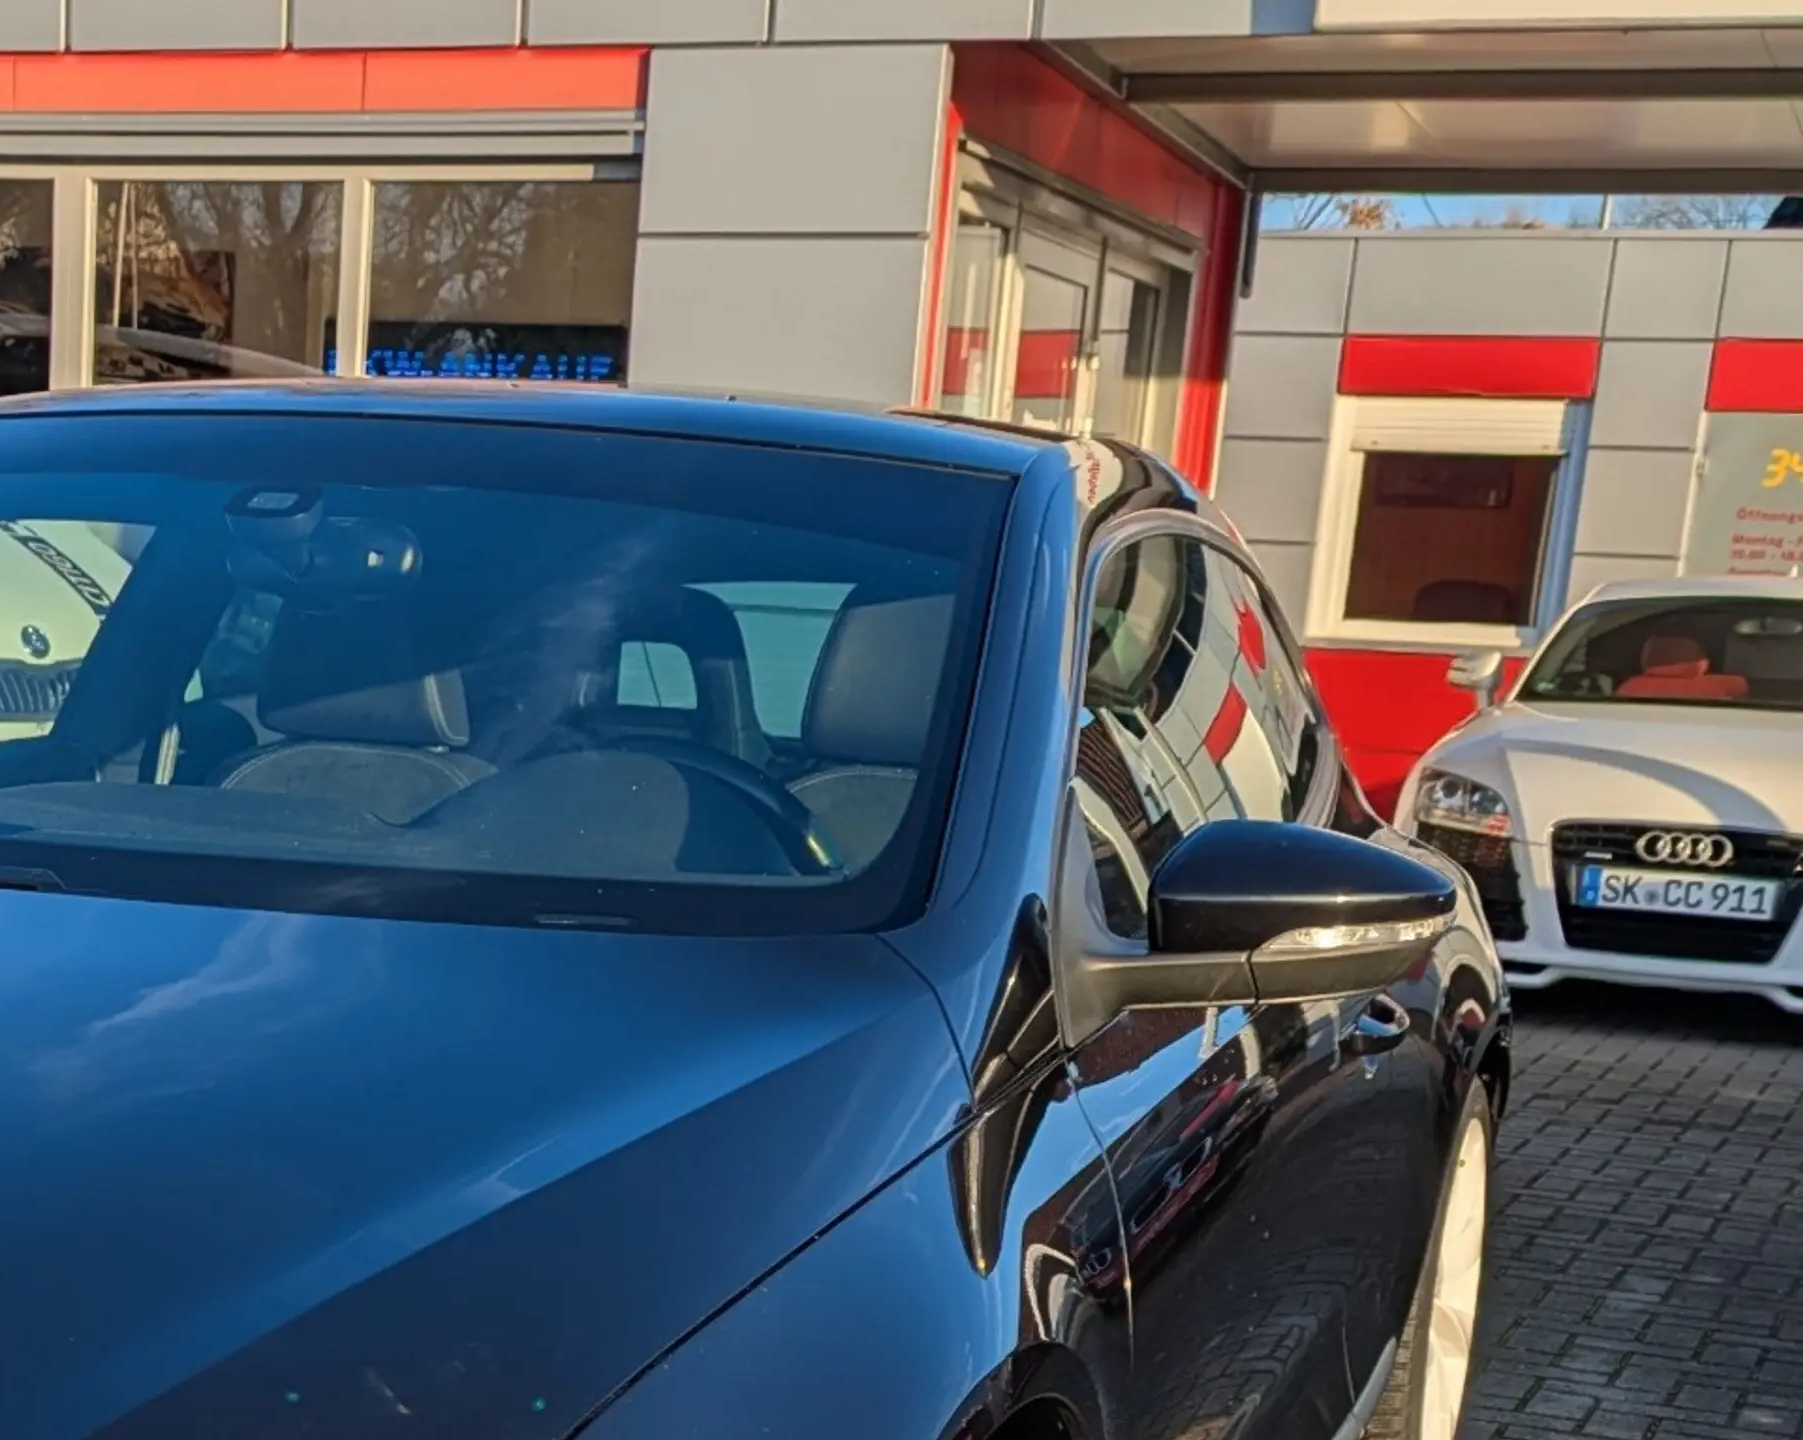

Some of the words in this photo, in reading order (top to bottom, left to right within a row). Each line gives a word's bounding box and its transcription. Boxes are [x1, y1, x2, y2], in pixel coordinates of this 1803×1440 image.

[1602, 875, 1643, 904] SK
[1664, 880, 1704, 908] CC
[1712, 883, 1767, 914] 911
